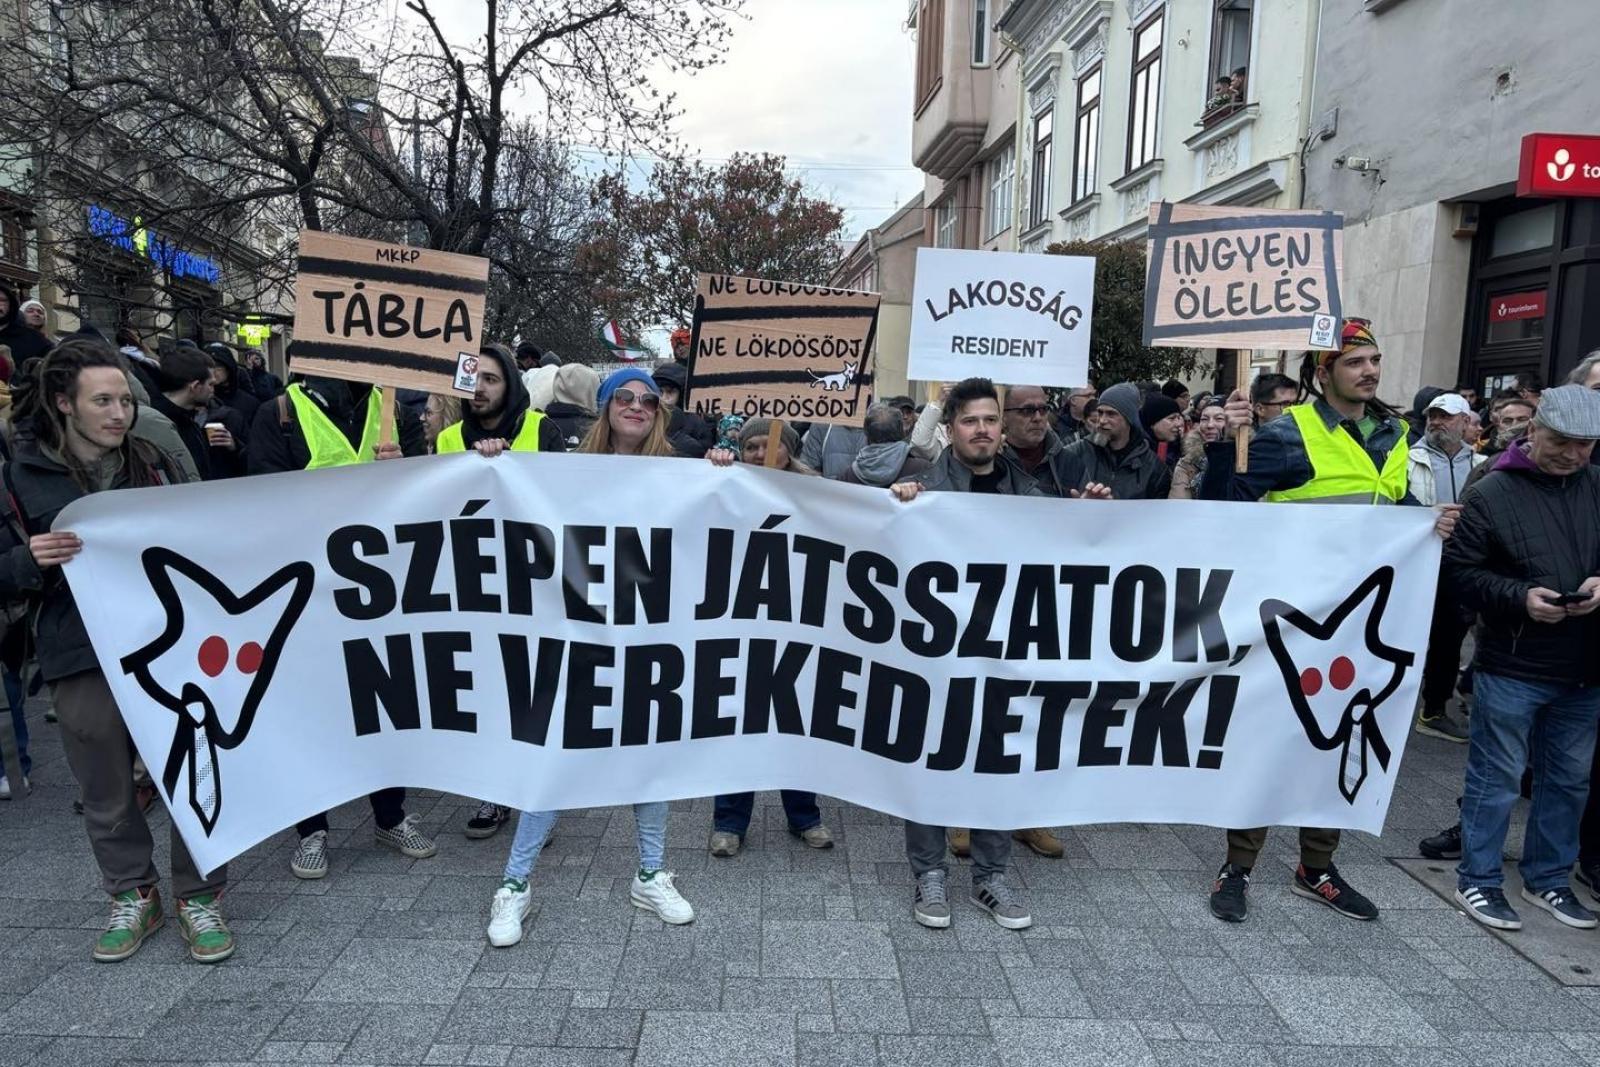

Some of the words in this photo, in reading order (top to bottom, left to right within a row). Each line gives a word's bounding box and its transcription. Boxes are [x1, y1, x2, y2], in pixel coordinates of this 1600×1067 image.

[375, 248, 420, 264] MKKP
[1173, 232, 1311, 276] INGYEN
[709, 276, 737, 296] NE
[925, 280, 1083, 331] LAKOSSÁG
[1174, 269, 1321, 320] ÖLELÉS
[313, 281, 473, 344] TÁBLA
[699, 337, 727, 358] NE
[736, 333, 863, 359] LÖKDÖSŐDJ
[951, 335, 1049, 358] RESIDENT
[696, 398, 723, 416] NE
[731, 394, 856, 418] LÖKDÖSŐDJ
[326, 499, 673, 626] SZÉPEN
[694, 514, 1252, 668] JÁTSSZATOK,
[342, 631, 478, 737] NE
[497, 633, 1241, 774] VEREKEDJETEK!
